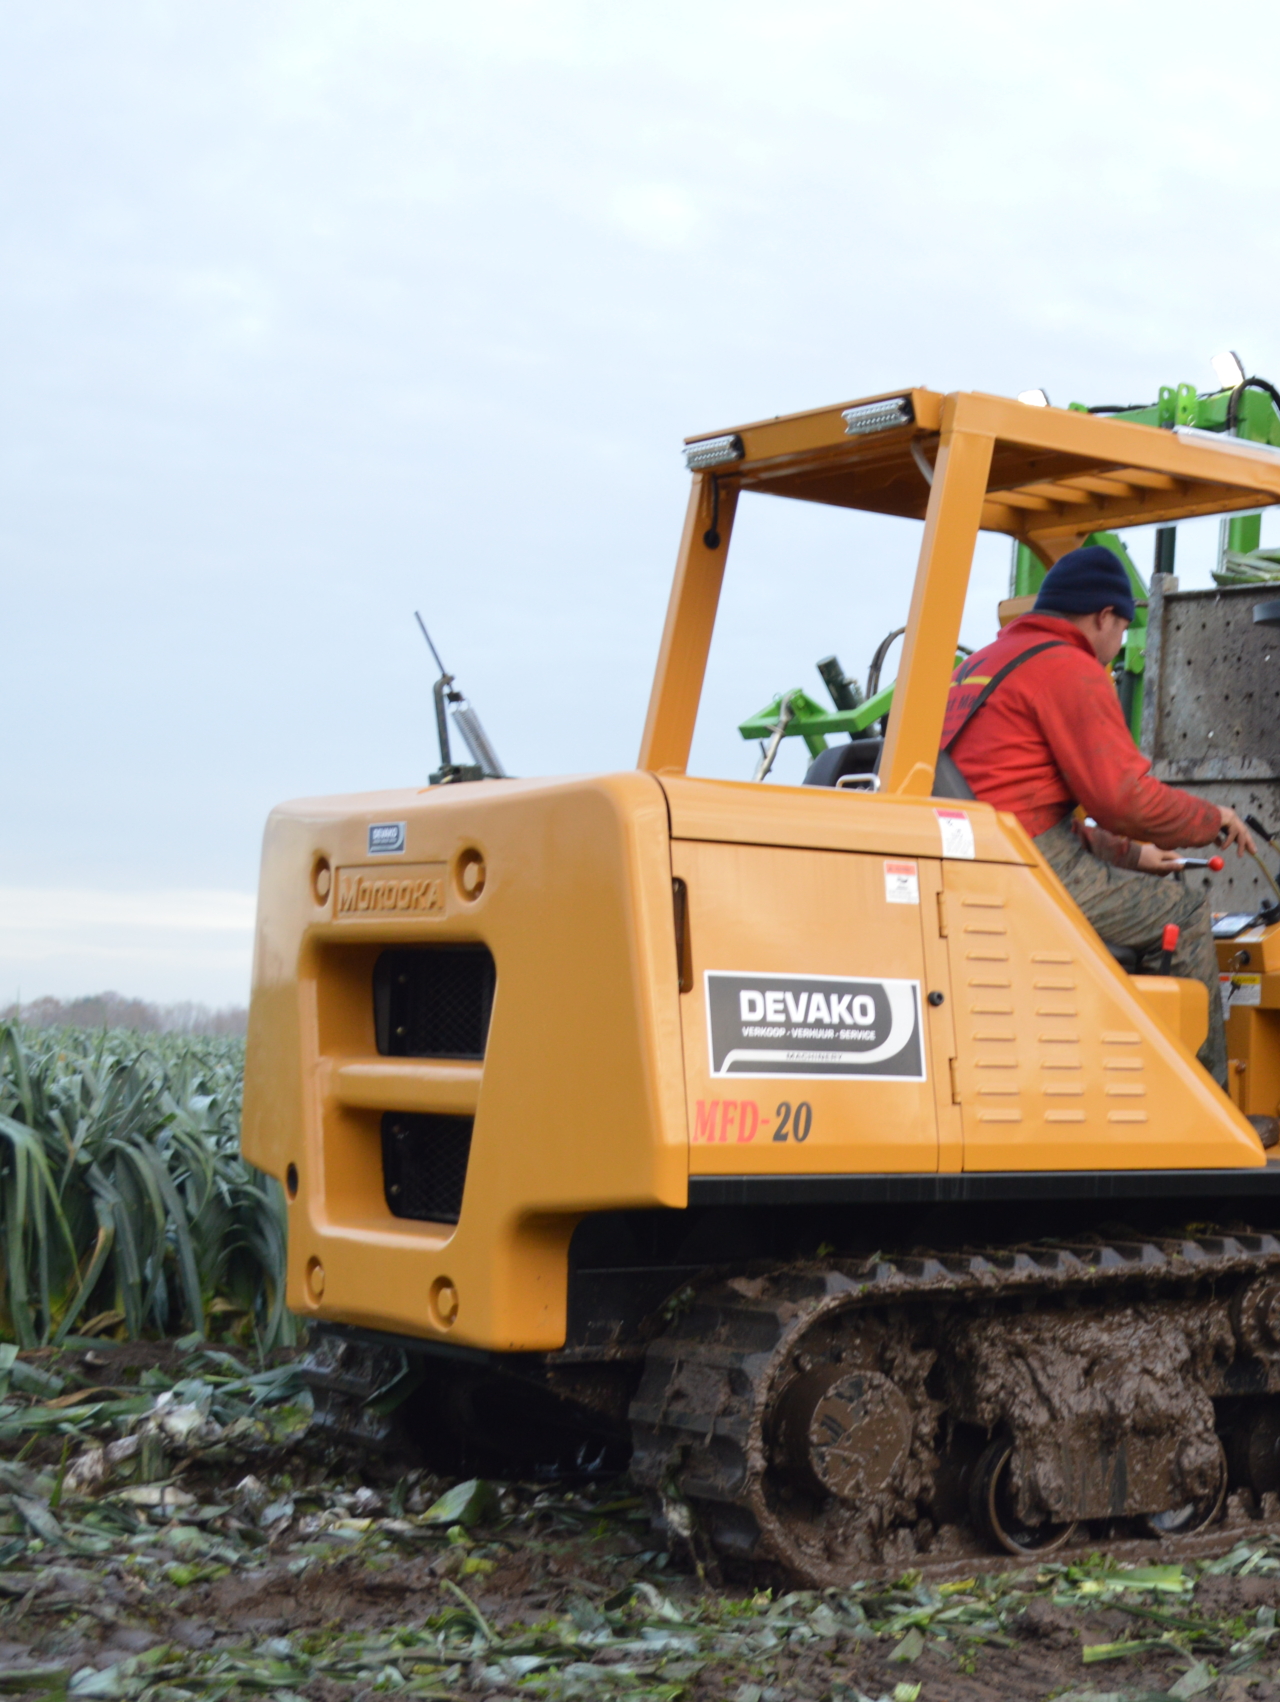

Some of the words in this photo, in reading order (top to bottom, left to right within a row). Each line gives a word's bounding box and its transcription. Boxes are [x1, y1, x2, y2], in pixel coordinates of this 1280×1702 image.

[739, 989, 876, 1026] DEVAKO
[741, 1026, 786, 1038] VERKOOP
[791, 1027, 835, 1039] VERHUUR
[839, 1029, 876, 1041] SERVICE
[786, 1051, 843, 1061] MACHINERY
